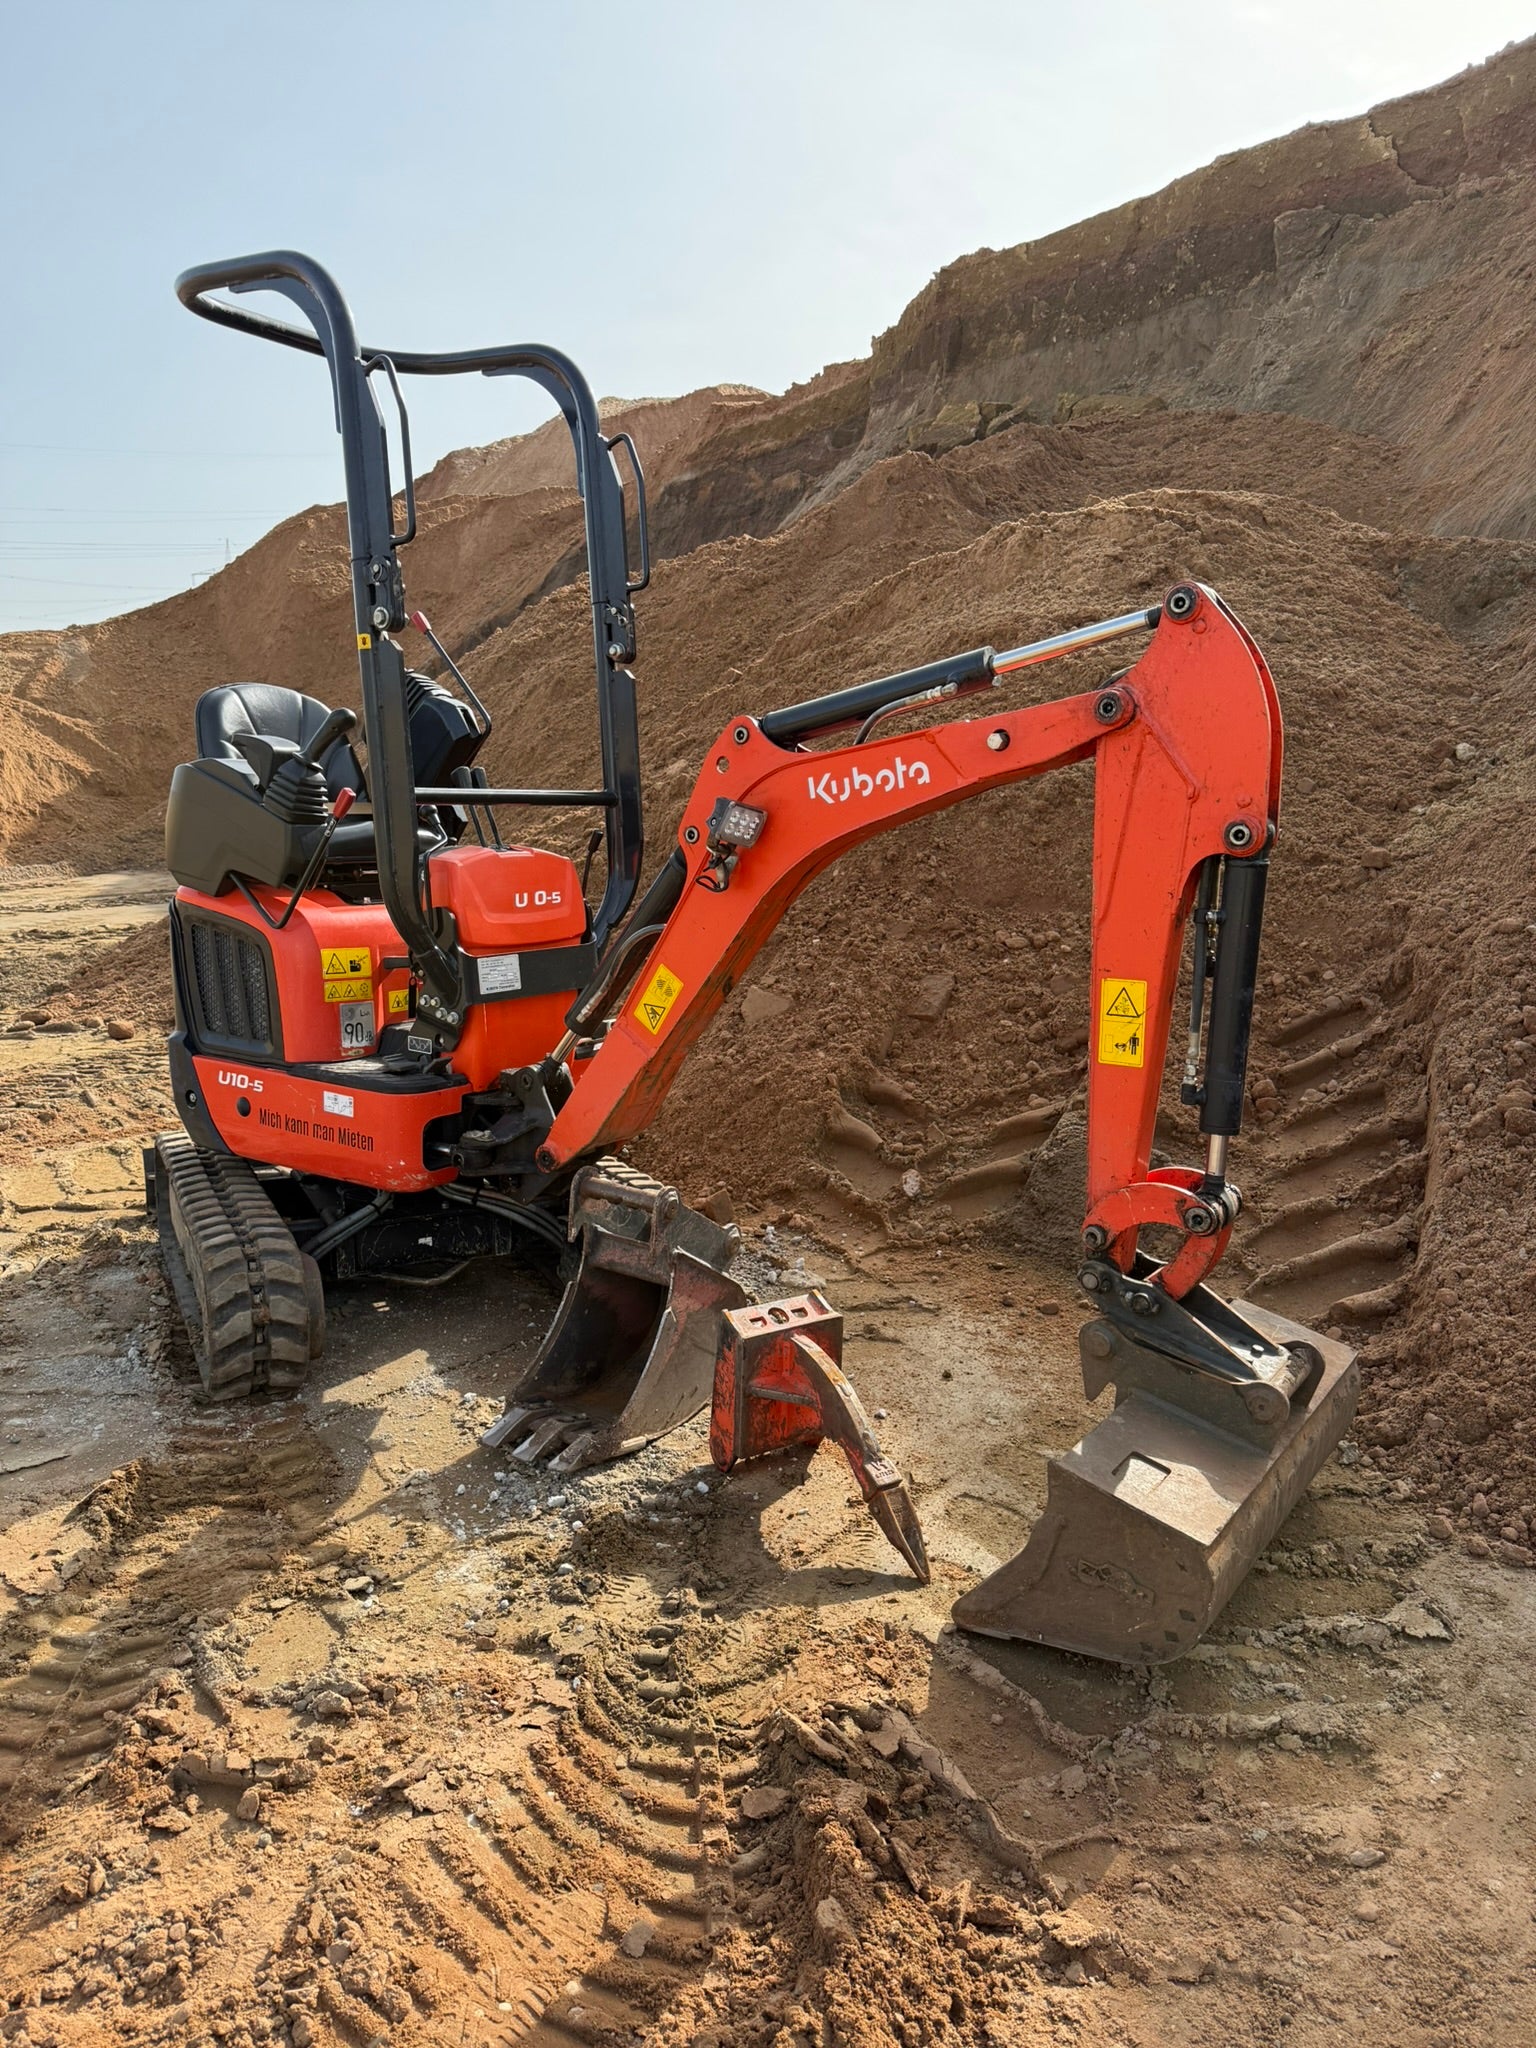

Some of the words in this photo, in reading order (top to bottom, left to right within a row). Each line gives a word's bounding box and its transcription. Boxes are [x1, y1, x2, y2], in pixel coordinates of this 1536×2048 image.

[808, 757, 930, 804] Kubota
[344, 1022, 364, 1044] 90
[218, 1070, 264, 1093] U10-5
[259, 1108, 282, 1130] Mich
[285, 1114, 309, 1137] kann
[312, 1122, 335, 1144] man
[338, 1127, 374, 1152] Mieten
